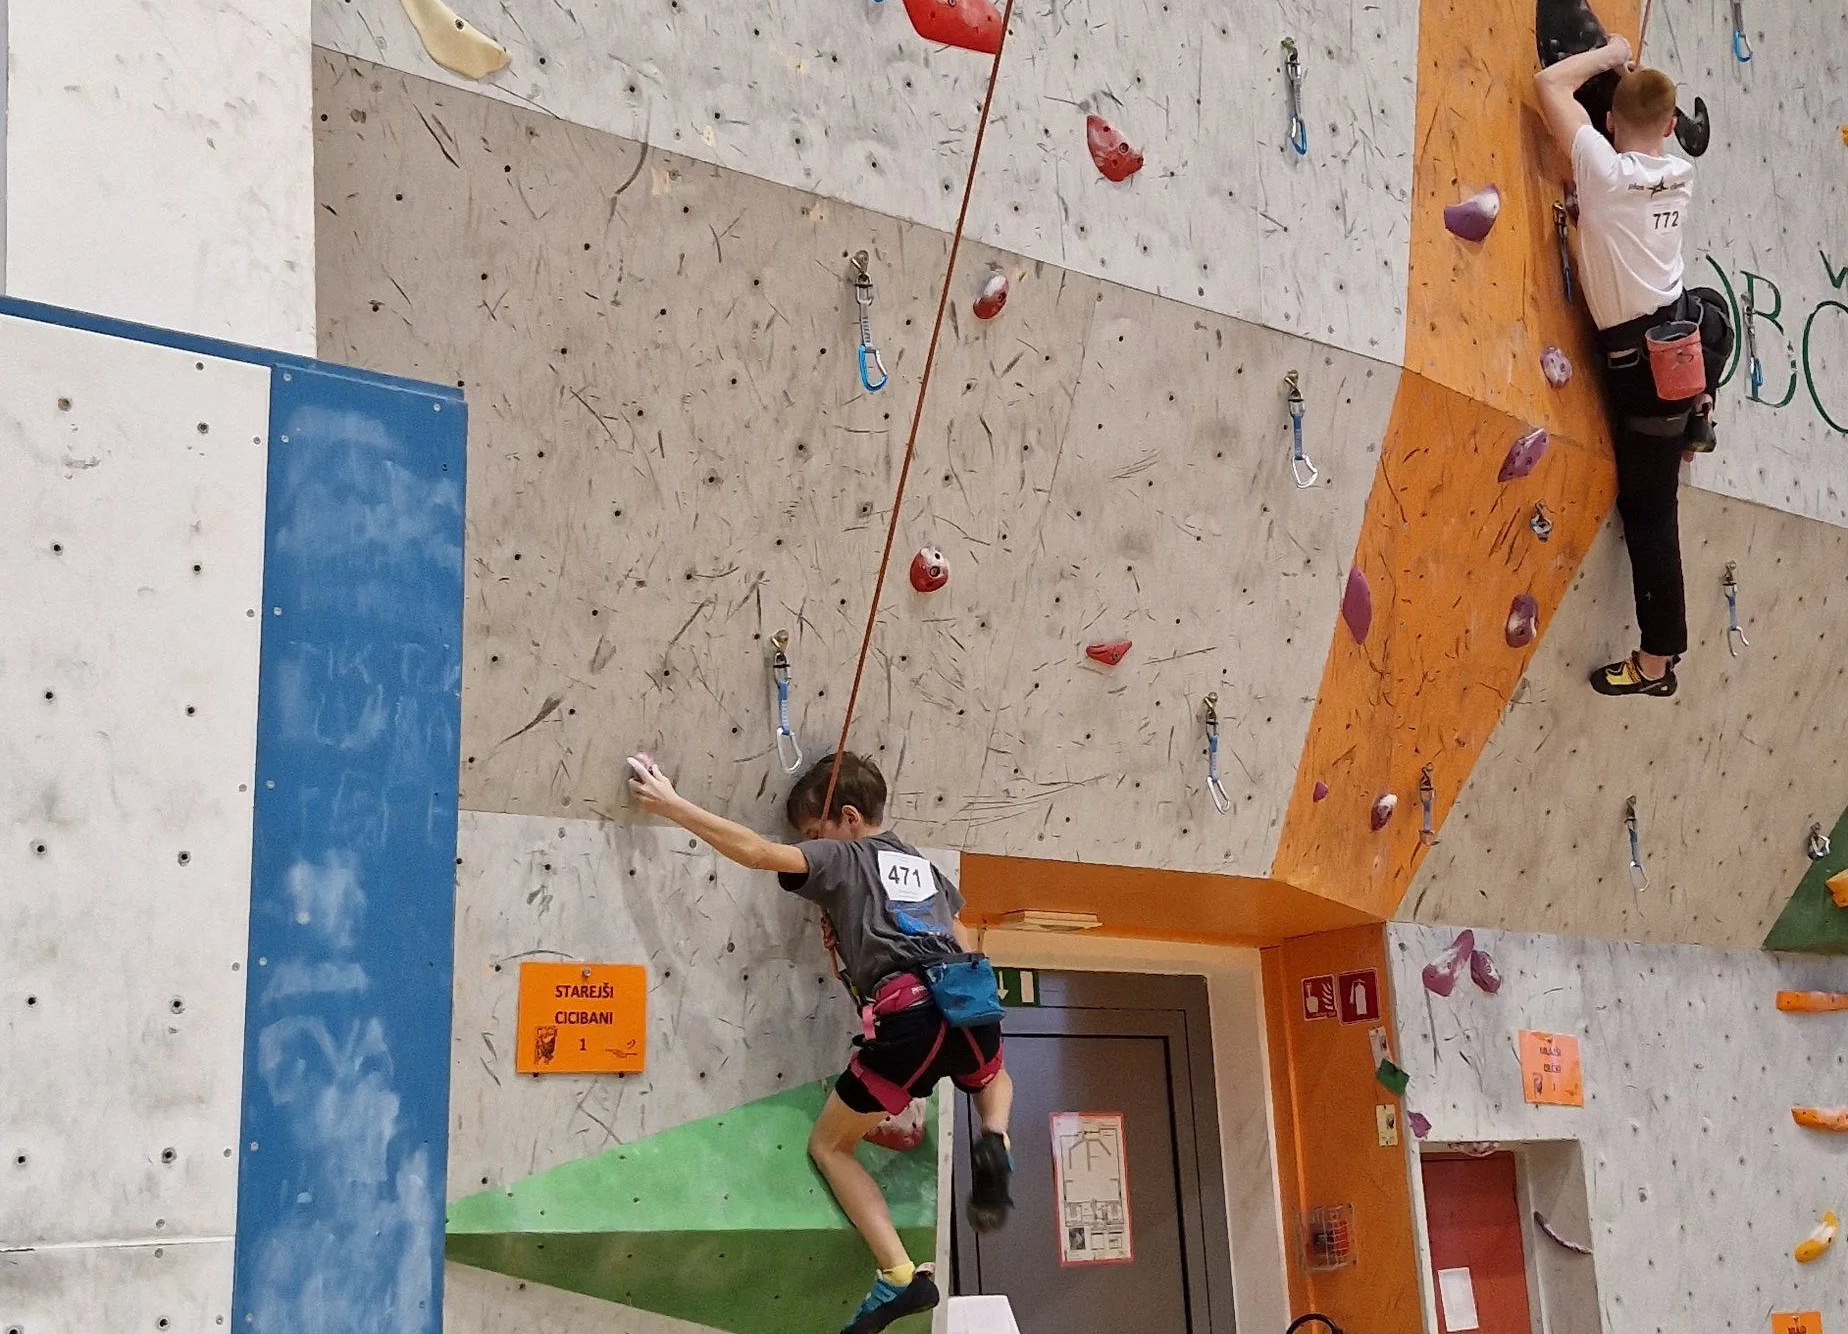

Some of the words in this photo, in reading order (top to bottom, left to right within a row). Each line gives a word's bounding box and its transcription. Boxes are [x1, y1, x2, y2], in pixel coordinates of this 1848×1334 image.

[1652, 210, 1680, 230] 772
[888, 864, 921, 888] 471
[554, 982, 614, 999] STAREJŠI
[554, 1011, 613, 1025] CICIBANI
[579, 1038, 587, 1052] 1
